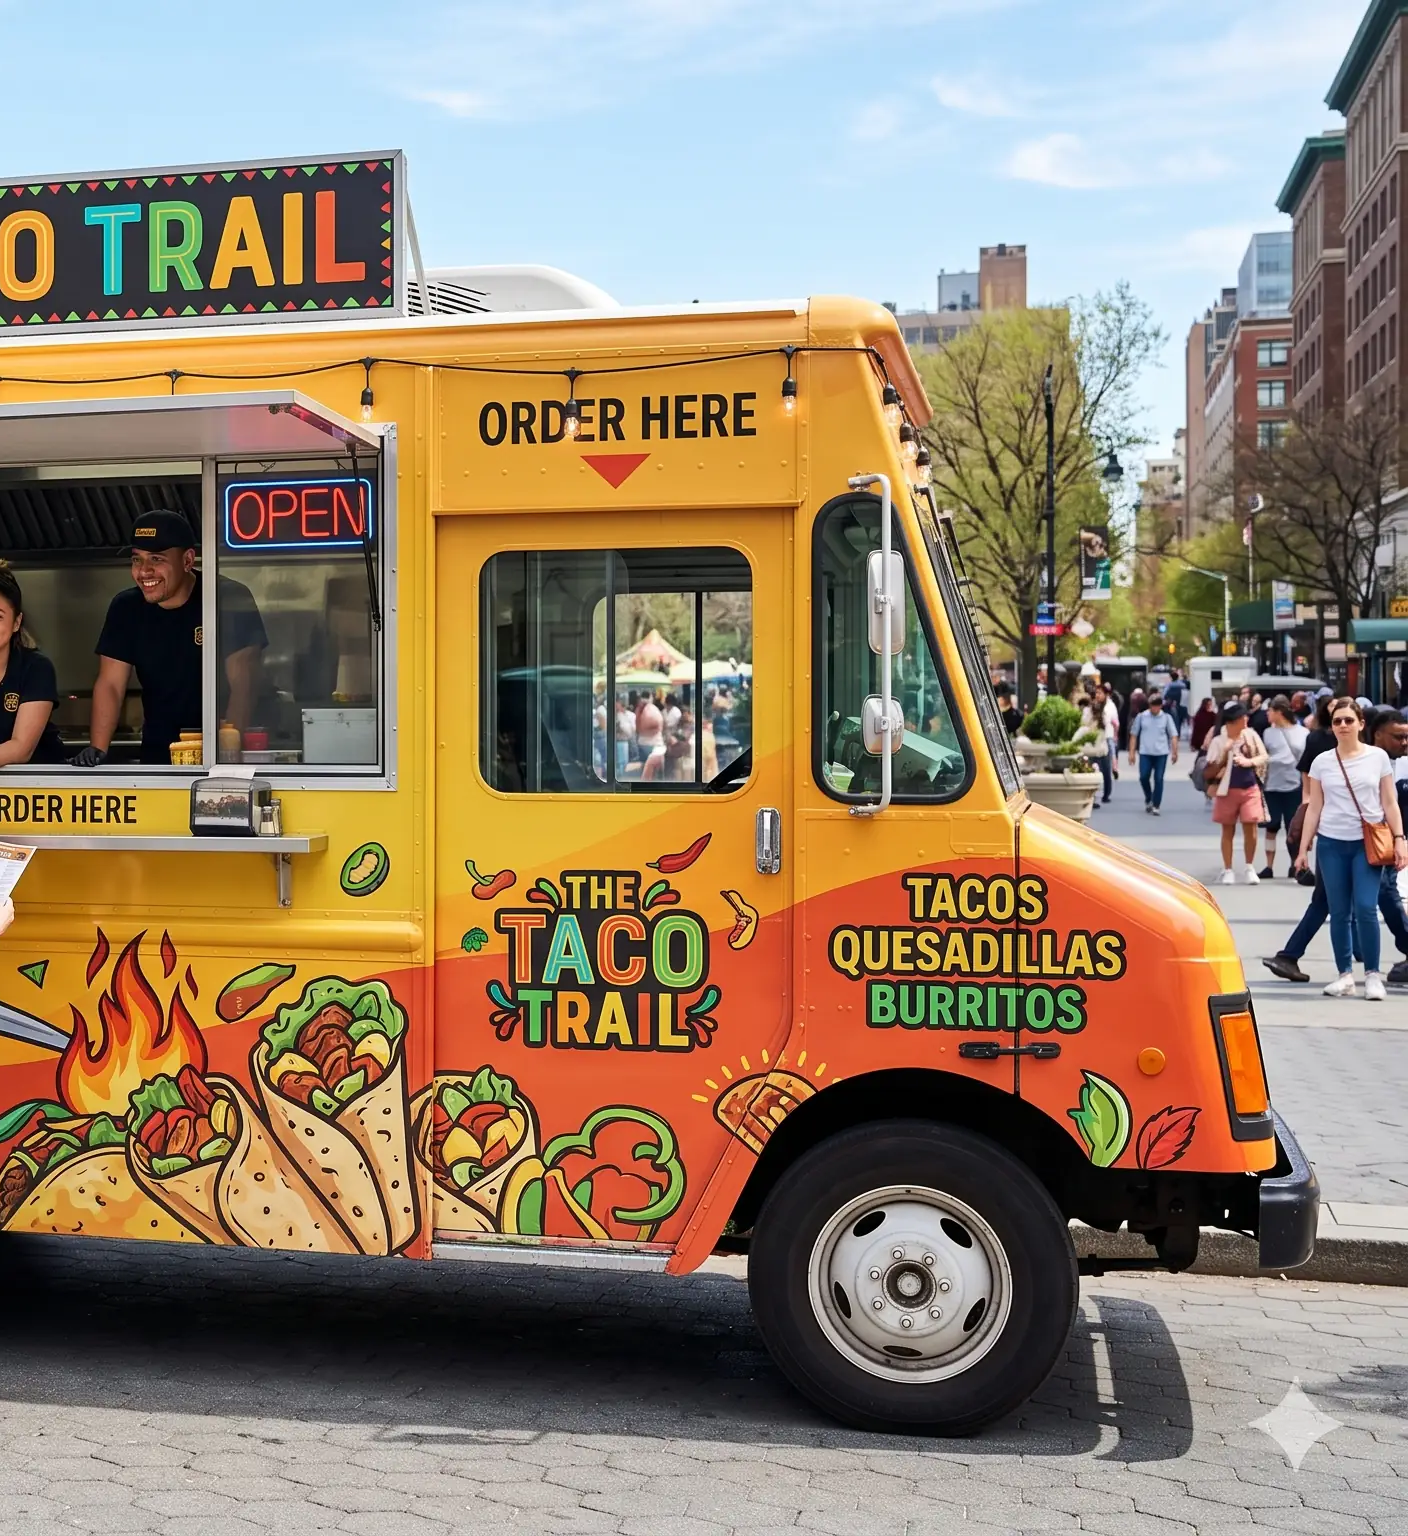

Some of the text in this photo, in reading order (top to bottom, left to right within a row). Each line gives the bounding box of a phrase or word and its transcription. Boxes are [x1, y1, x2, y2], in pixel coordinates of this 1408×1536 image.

[84, 190, 366, 296] TRAIL
[479, 392, 757, 446] ORDER HERE
[232, 486, 365, 540] OPEN
[71, 795, 137, 823] HERE
[565, 876, 635, 909] THE
[906, 877, 1044, 921] TACOS
[500, 914, 703, 988] TACO
[832, 930, 1123, 976] QUESADILLAS
[518, 989, 689, 1047] TRAIL
[870, 983, 1083, 1030] BURRITOS
